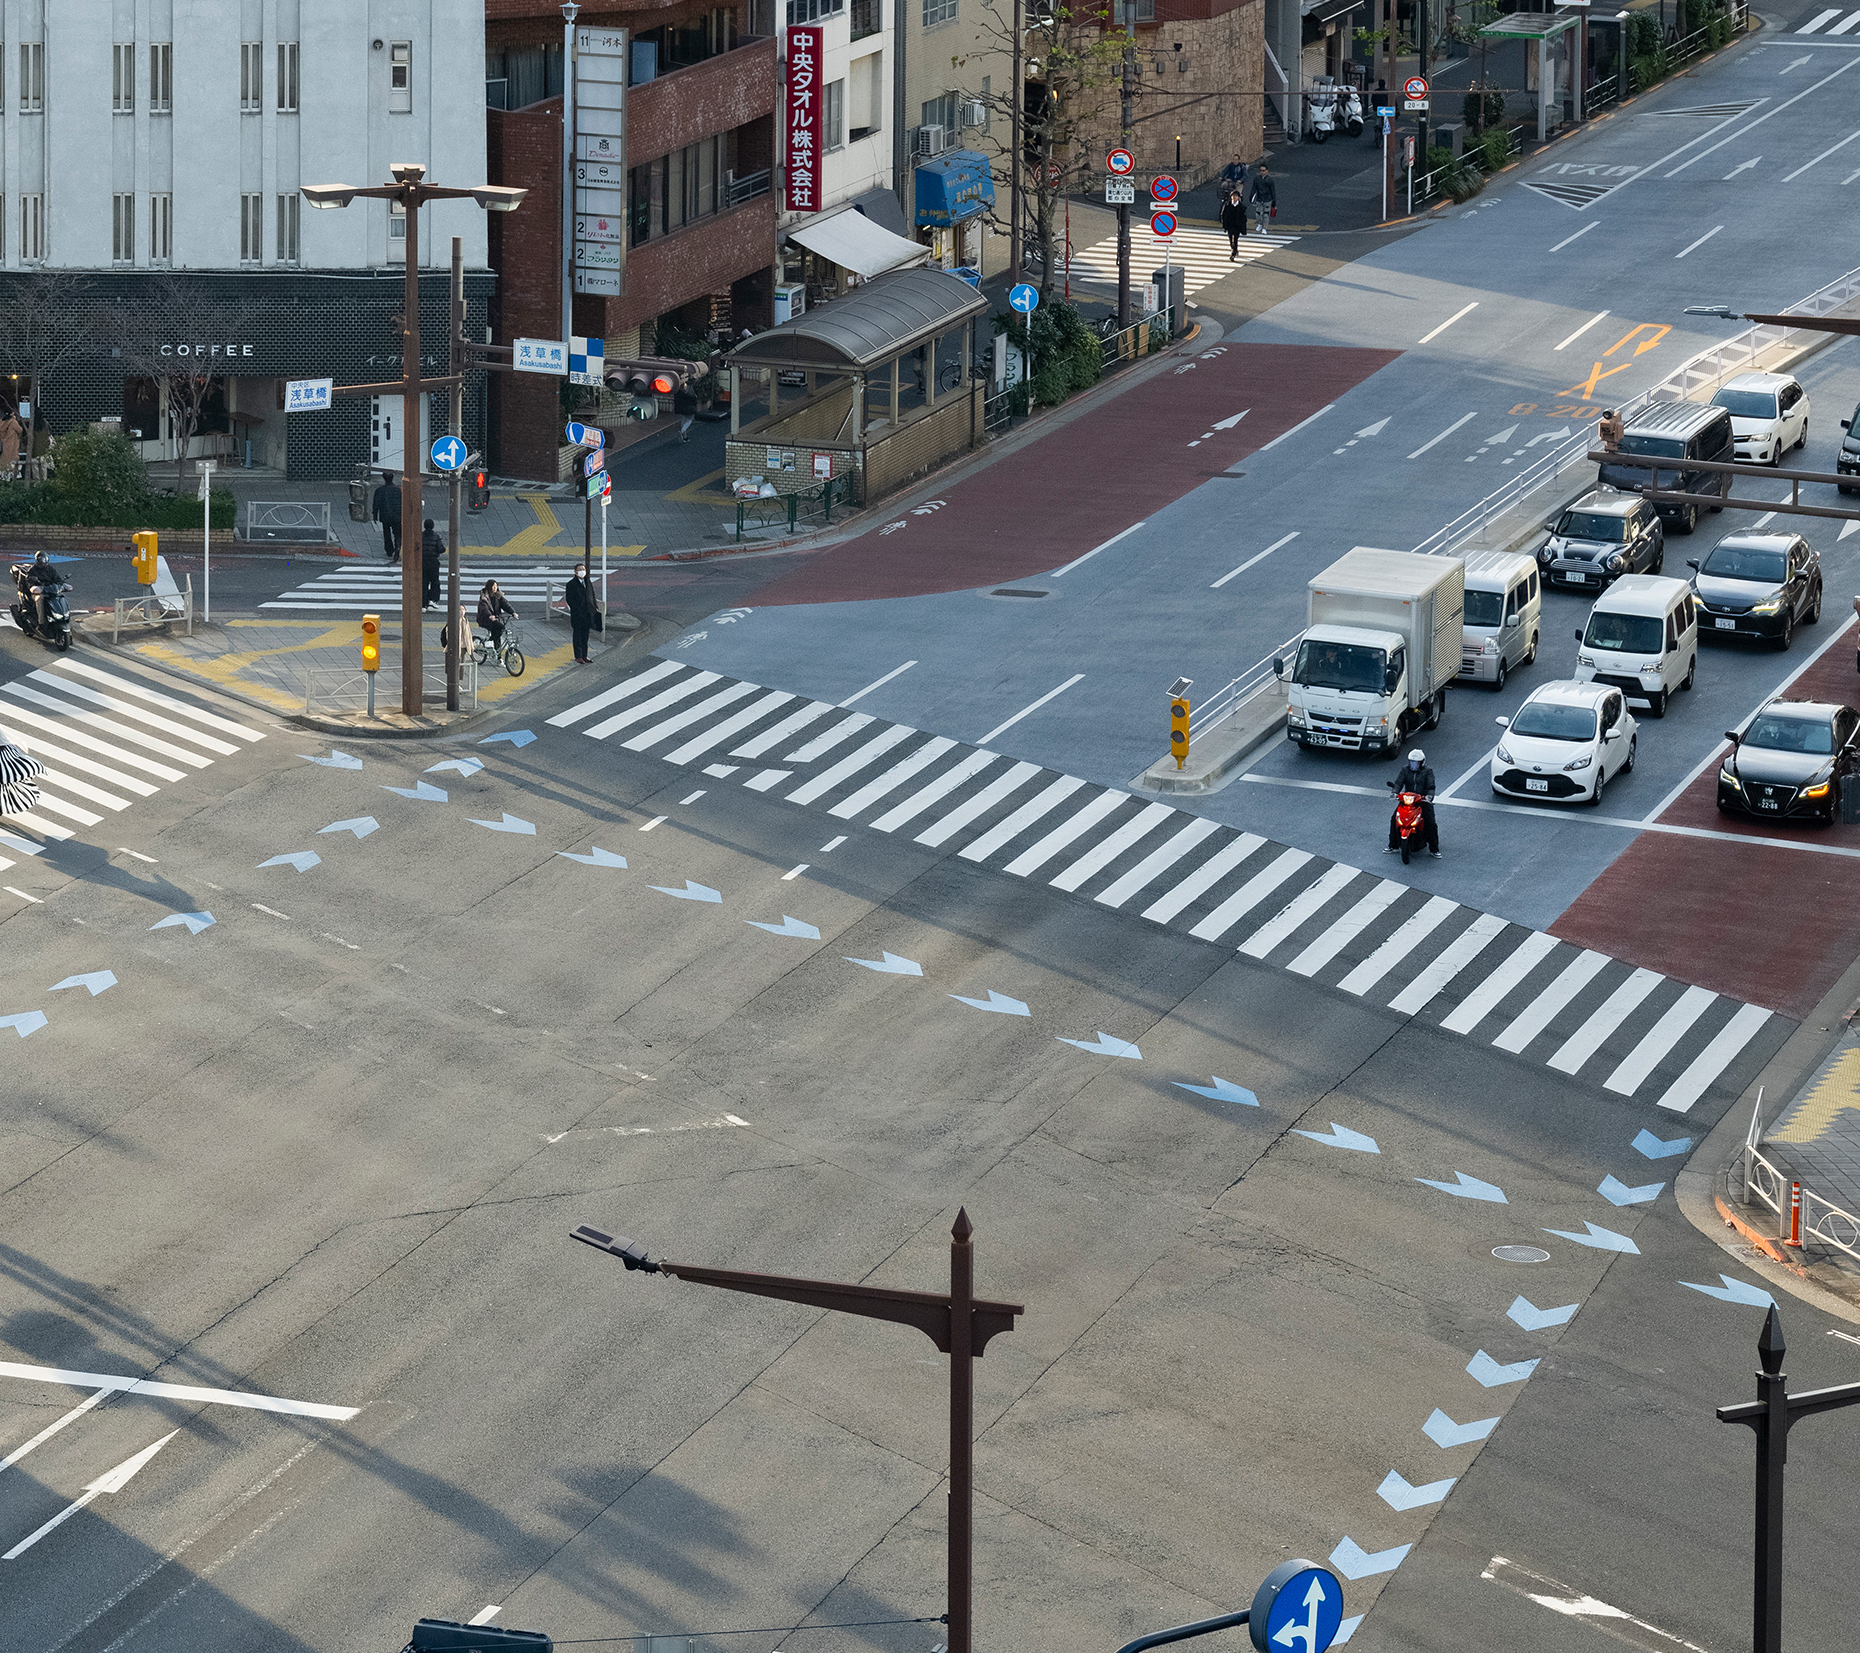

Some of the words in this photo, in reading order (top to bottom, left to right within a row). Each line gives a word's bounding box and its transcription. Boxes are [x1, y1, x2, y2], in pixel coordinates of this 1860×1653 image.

[580, 36, 589, 46] 11
[792, 32, 814, 207] 中央タオル株式会社
[577, 169, 586, 179] 3
[577, 221, 585, 233] 2
[577, 248, 584, 259] 2
[577, 275, 583, 286] 1
[160, 344, 254, 357] COFFEE
[519, 345, 562, 361] 浅草橋
[519, 359, 563, 370] Asakusabashi
[571, 372, 603, 386] 時差式
[290, 387, 327, 401] 浅草橋
[289, 399, 328, 409] Asakusabashi
[1508, 403, 1602, 419] 8-20
[1311, 704, 1361, 714] FUSO
